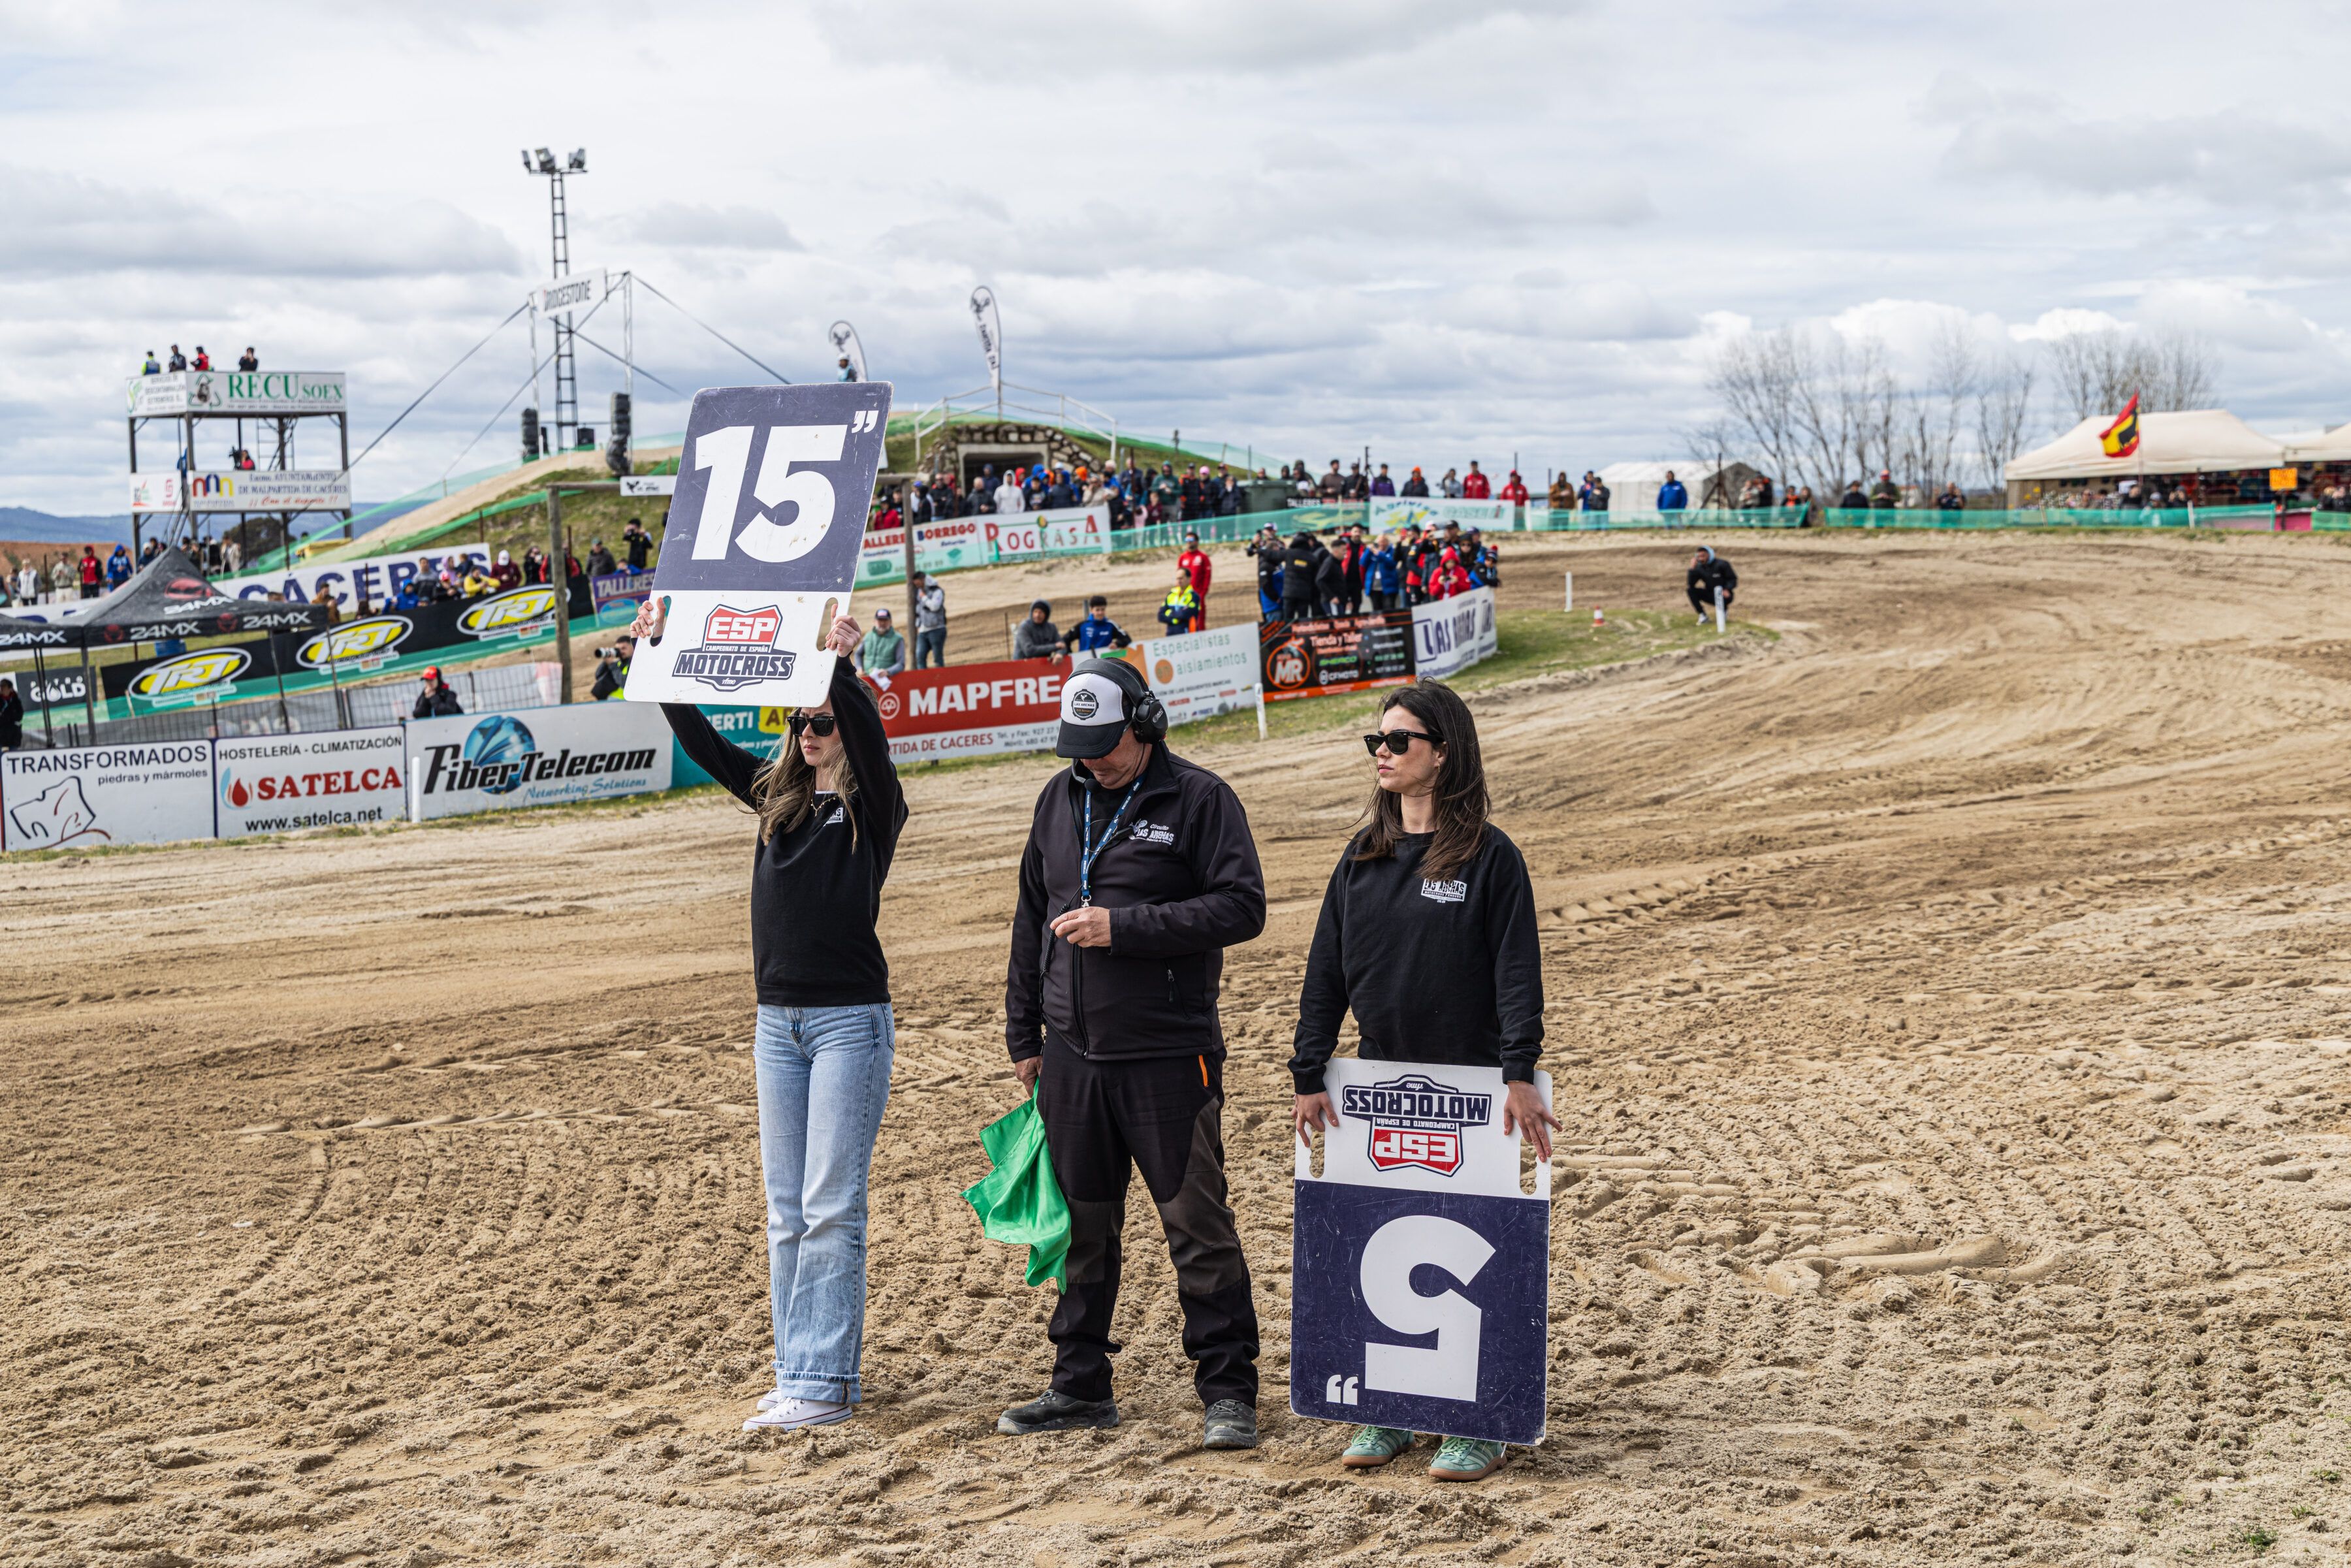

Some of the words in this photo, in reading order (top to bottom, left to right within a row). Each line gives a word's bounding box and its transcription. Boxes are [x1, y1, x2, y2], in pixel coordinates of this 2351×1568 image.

[543, 280, 590, 312] BRIDGESTONE
[227, 374, 299, 399] RECU
[864, 534, 906, 549] ALLERE
[917, 522, 975, 541] BORREGO
[985, 515, 1101, 552] ROGRASA
[238, 552, 488, 609] CÁCERS
[164, 595, 235, 615] 24MX
[130, 621, 201, 640] 24MX
[243, 611, 312, 629] 24MX
[708, 616, 776, 640] ESP
[1153, 633, 1230, 657] Especialistas
[1309, 634, 1337, 647] Tienda
[675, 654, 793, 677] MOTOCROSS
[1176, 652, 1248, 675] aislamientos
[909, 675, 1061, 717] MAPFRE
[219, 743, 301, 761] HOSTELERÍA
[312, 736, 402, 755] CLIMATIZACIÓN
[921, 738, 936, 752] DE
[940, 733, 993, 750] CACERES
[8, 745, 208, 775] TRANSFORMADOS
[97, 773, 141, 786] piedras
[143, 773, 150, 783] y
[152, 768, 208, 781] mármoles
[257, 766, 403, 801] SATELCA
[523, 783, 589, 805] Networking
[589, 776, 647, 794] Solutions
[245, 806, 383, 832] www.satelca.net
[1136, 828, 1149, 837] LAS
[1149, 830, 1175, 842] ARENAS
[1345, 1089, 1488, 1121] MOTOCROSS
[1376, 1117, 1399, 1127] ESPAÑA
[1413, 1119, 1455, 1130] CAMPEONATO
[1375, 1132, 1456, 1162] ESP
